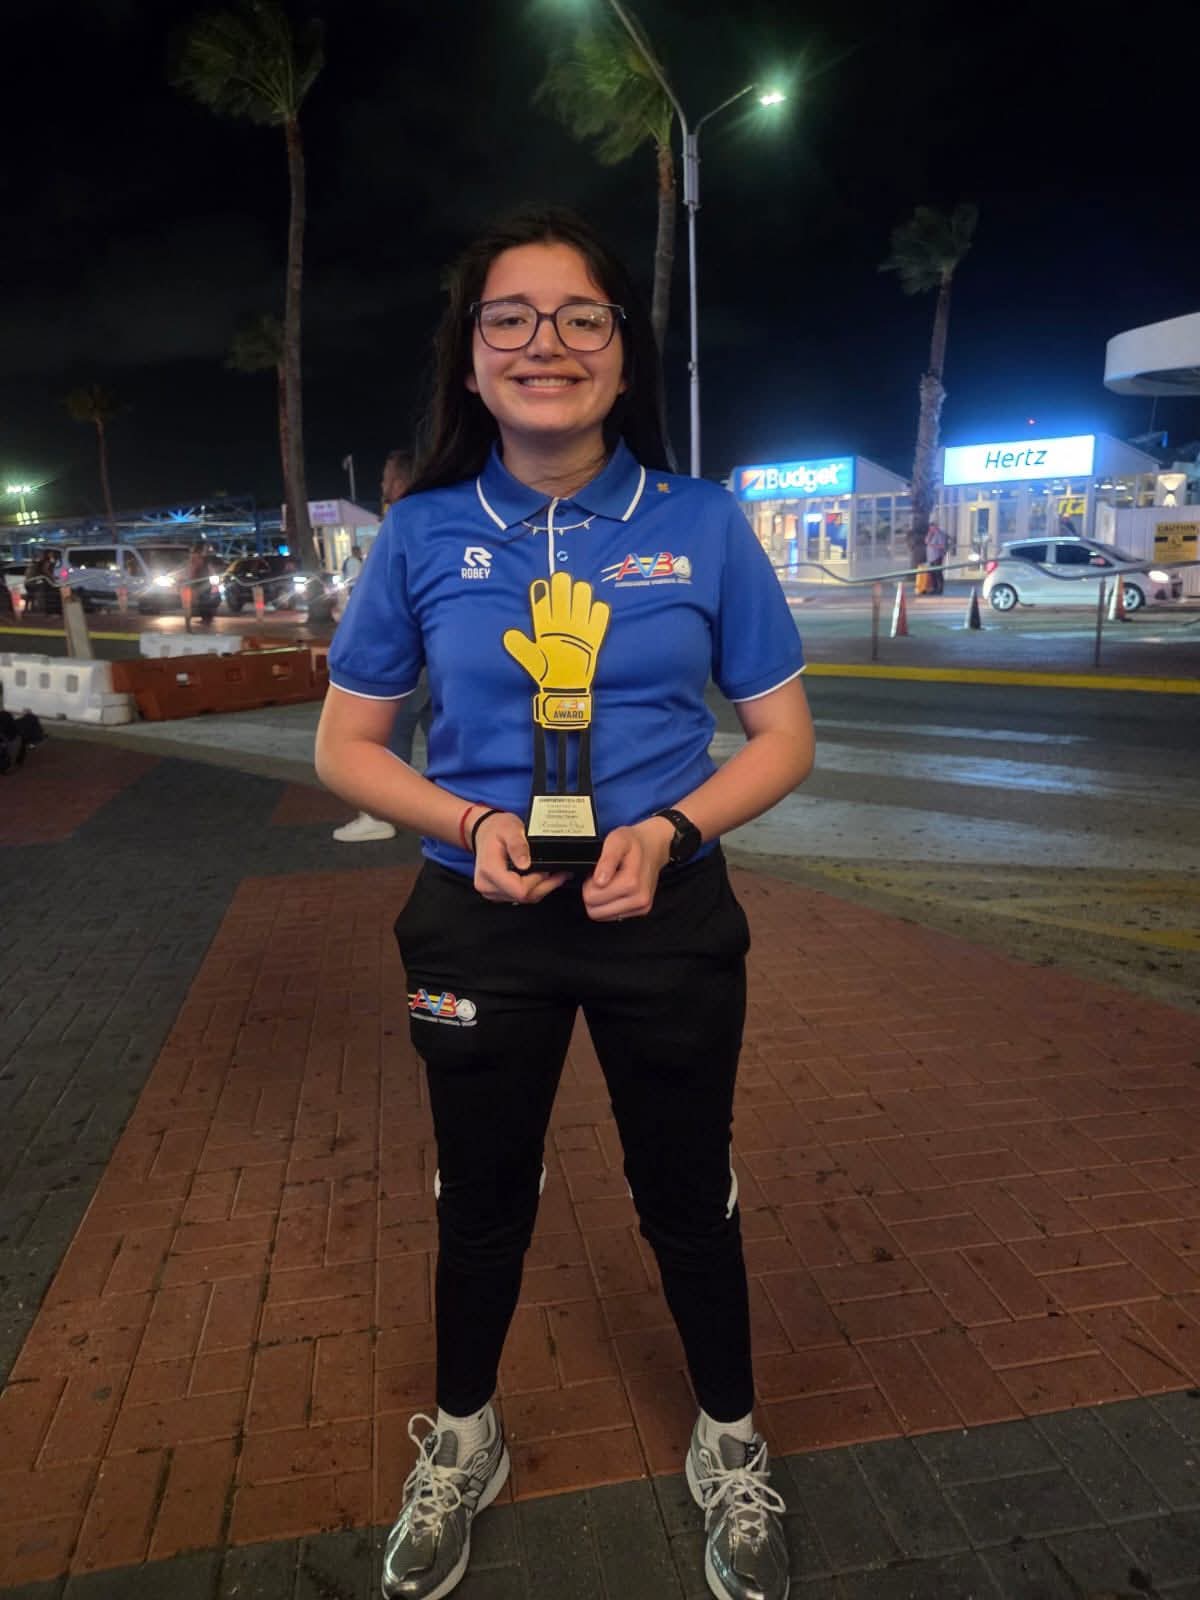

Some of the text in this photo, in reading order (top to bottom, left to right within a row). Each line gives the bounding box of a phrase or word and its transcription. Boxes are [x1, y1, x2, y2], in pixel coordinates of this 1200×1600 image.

[985, 448, 1048, 469] Hertz
[766, 464, 840, 493] Budget
[461, 567, 490, 579] ROBEY
[554, 710, 584, 720] AWARD
